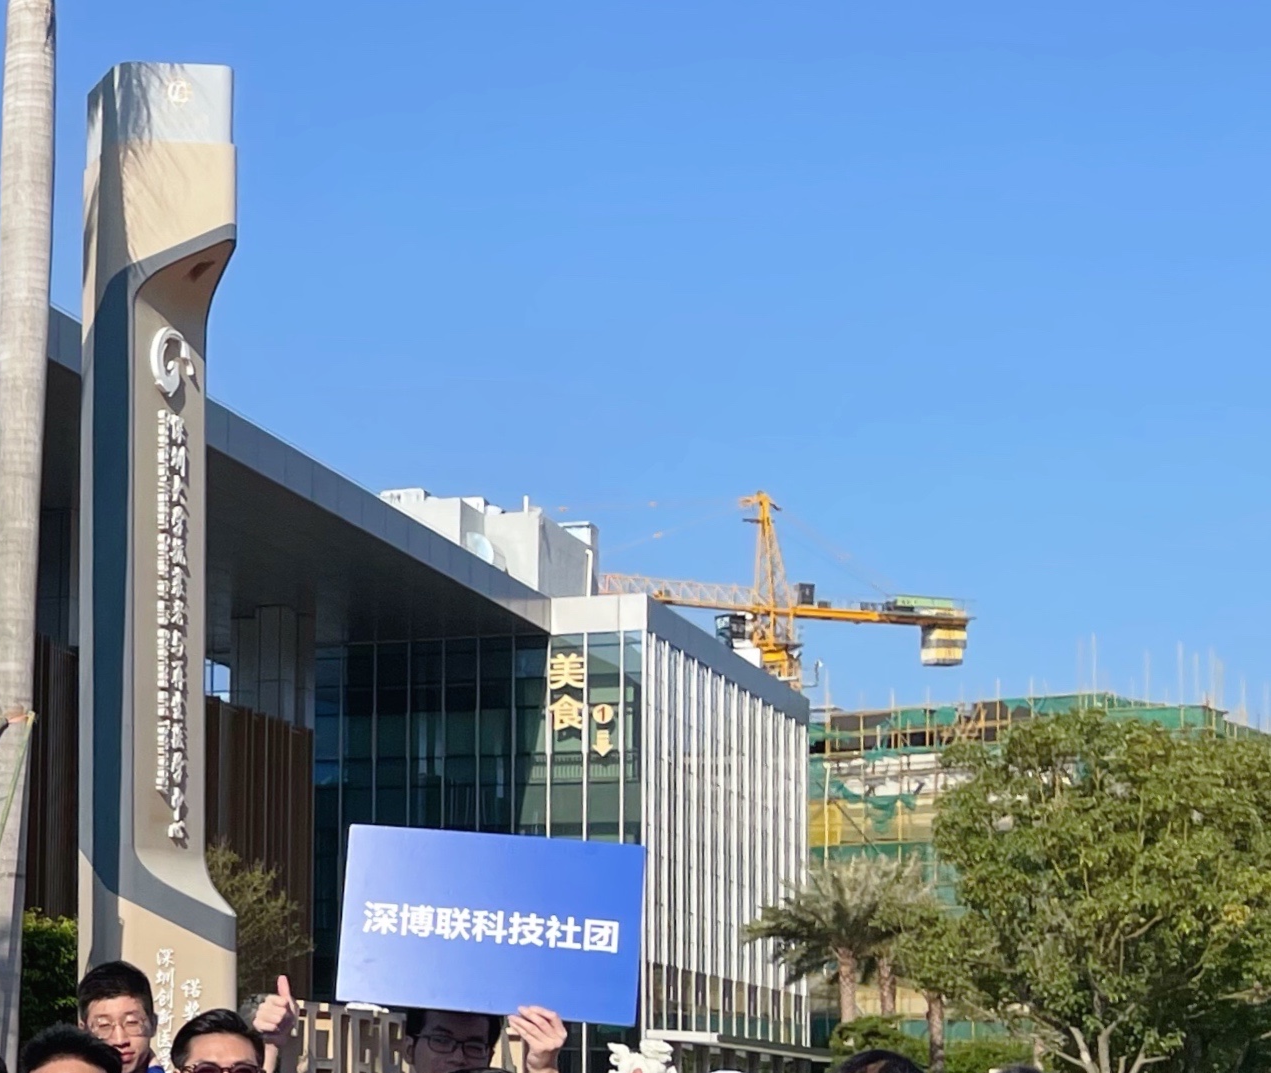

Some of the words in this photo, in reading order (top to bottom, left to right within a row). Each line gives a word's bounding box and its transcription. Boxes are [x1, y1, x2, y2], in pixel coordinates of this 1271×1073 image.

[362, 900, 620, 954] 深博联科技社团
